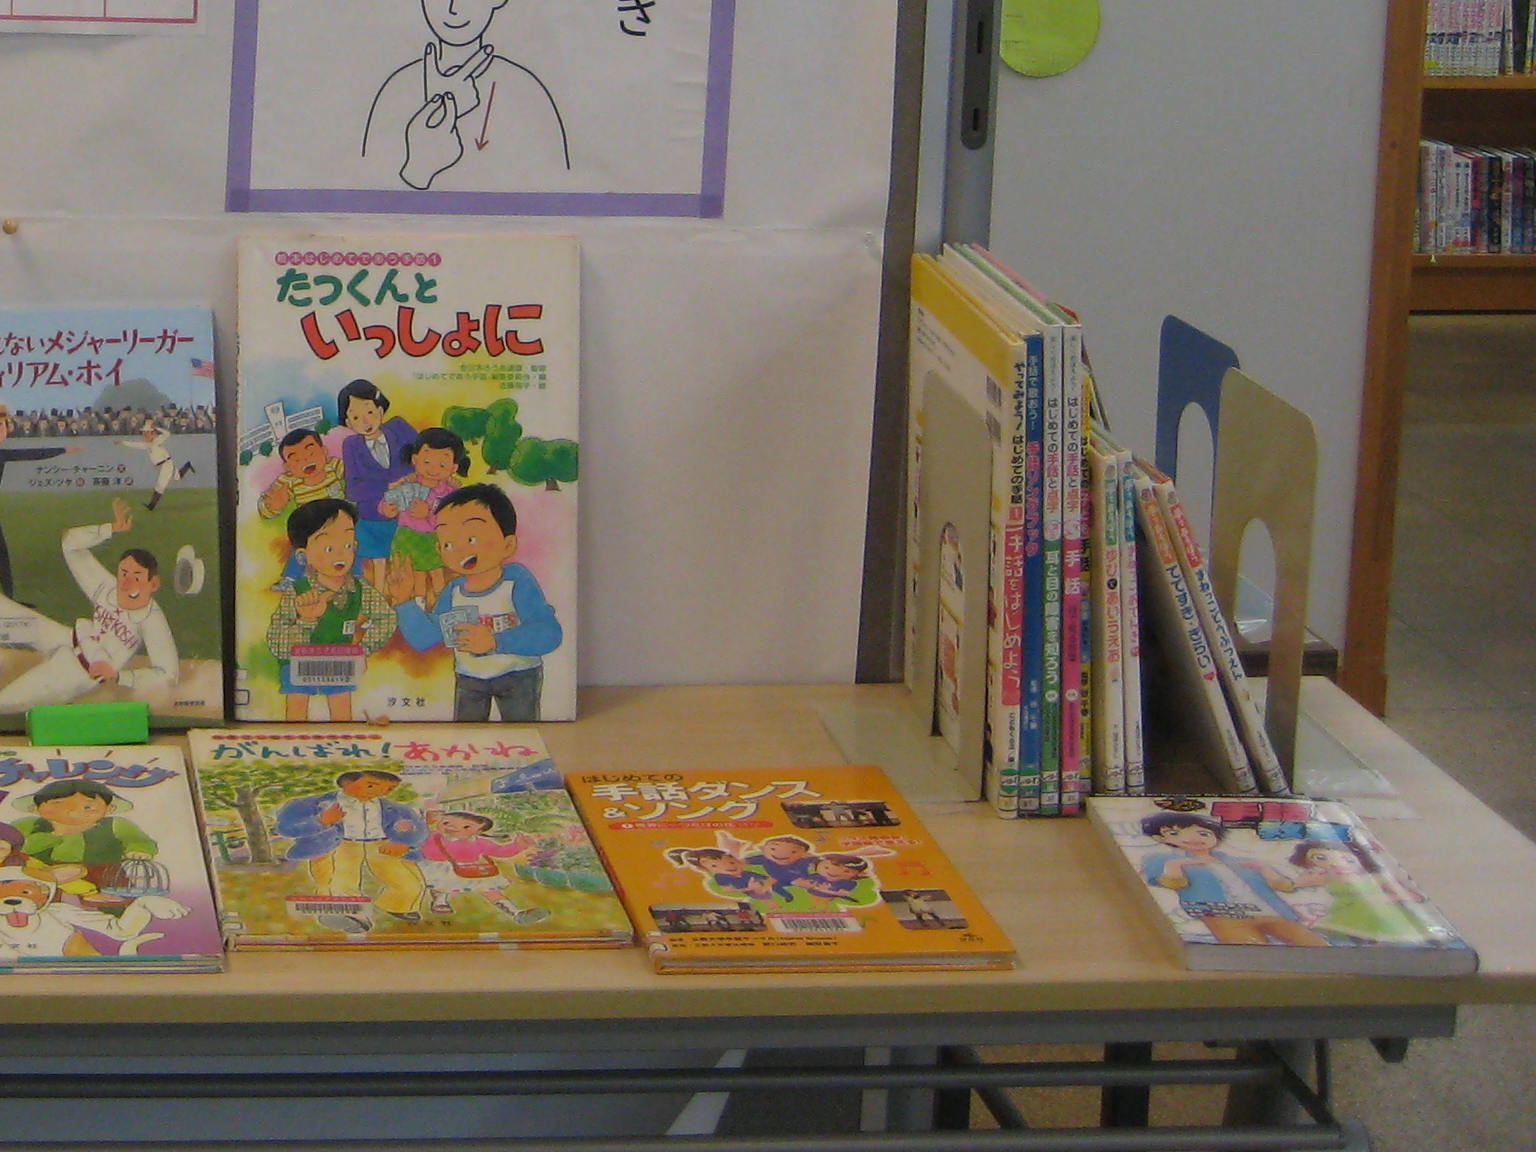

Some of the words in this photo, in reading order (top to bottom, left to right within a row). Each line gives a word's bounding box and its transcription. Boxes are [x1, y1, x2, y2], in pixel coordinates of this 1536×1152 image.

[277, 269, 438, 307] たつくんと
[300, 304, 544, 360] いっしょに
[590, 781, 823, 804] 手話ダンス
